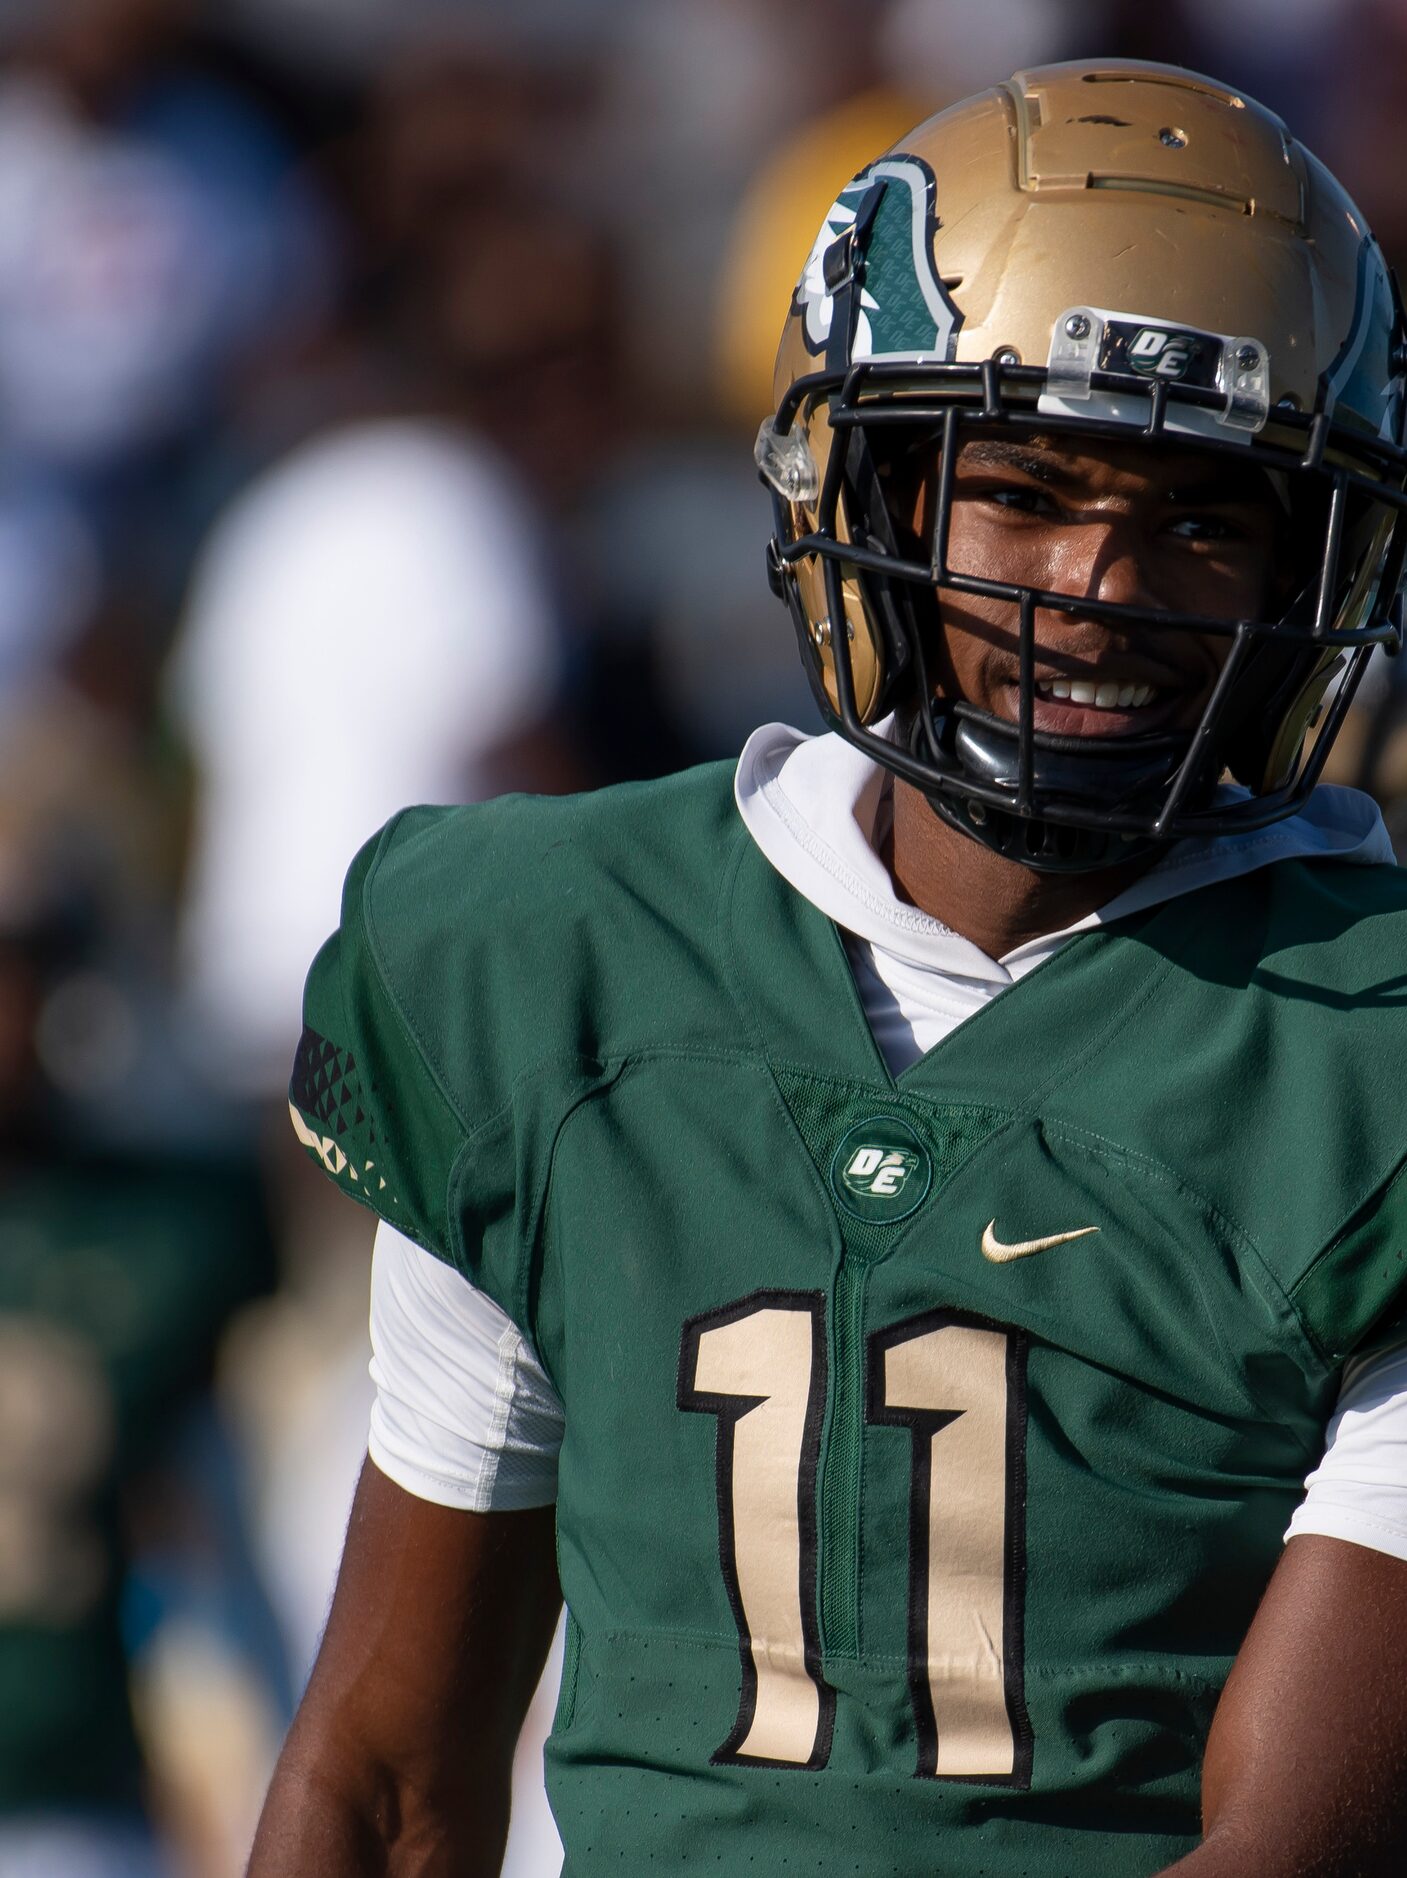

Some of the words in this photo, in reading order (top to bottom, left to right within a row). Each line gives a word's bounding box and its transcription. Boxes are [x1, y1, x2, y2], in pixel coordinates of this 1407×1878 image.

[1131, 330, 1189, 376] DE
[848, 1148, 905, 1194] DE
[678, 1288, 1034, 1789] 11
